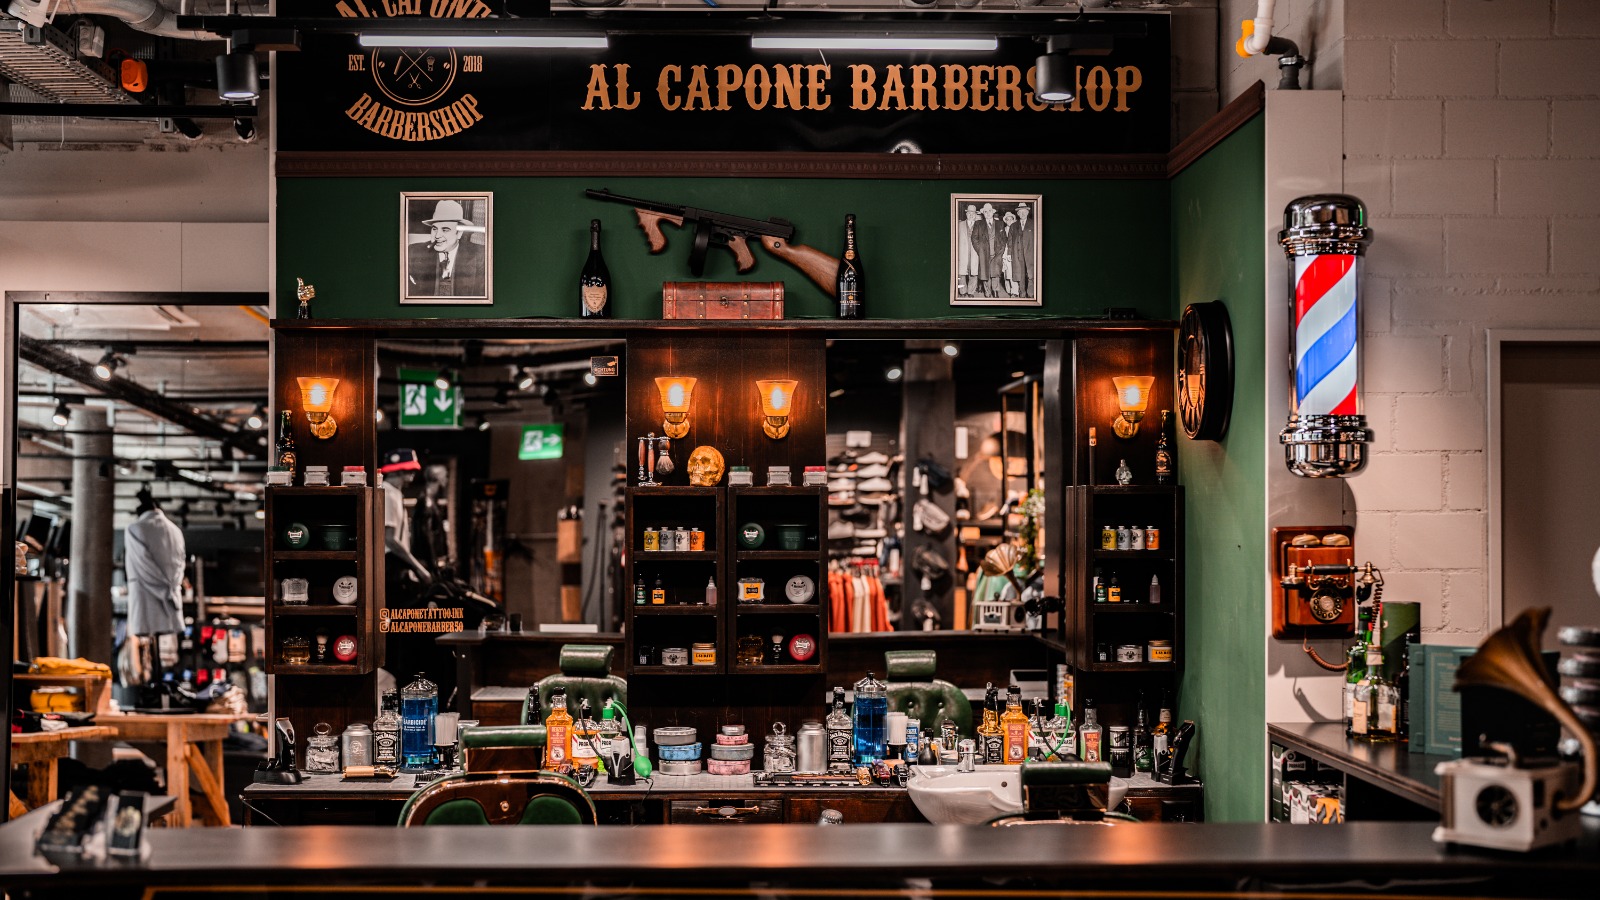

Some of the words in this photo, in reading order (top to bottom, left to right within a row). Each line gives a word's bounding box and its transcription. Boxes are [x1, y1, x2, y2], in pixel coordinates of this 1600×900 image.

[348, 54, 365, 71] EST.
[463, 55, 483, 72] 2018
[581, 63, 641, 111] AL
[656, 63, 832, 111] CAPONE
[344, 92, 484, 142] BARBERSHOP
